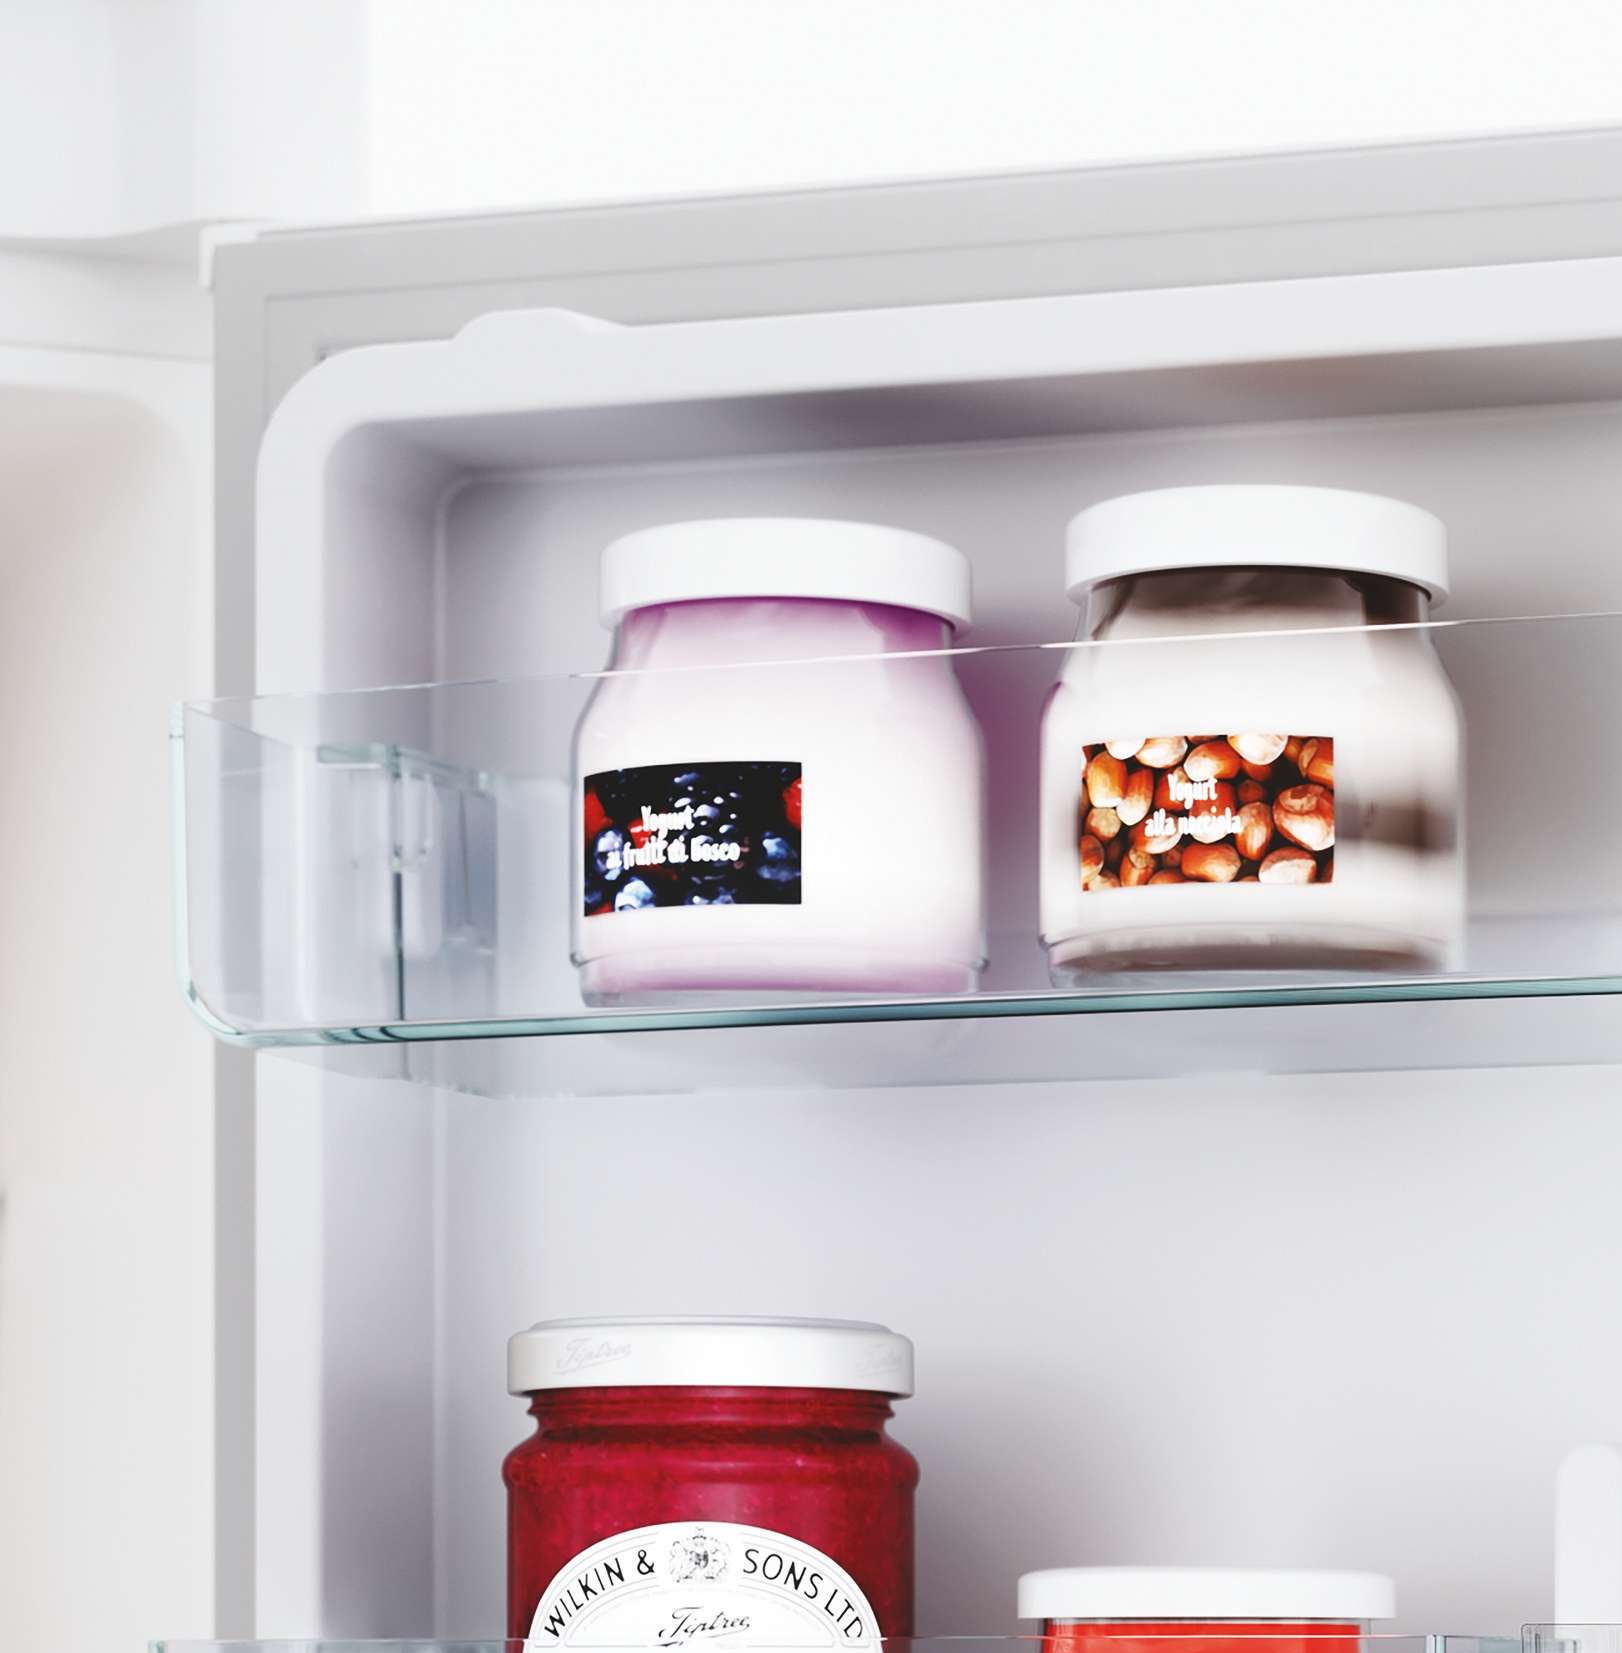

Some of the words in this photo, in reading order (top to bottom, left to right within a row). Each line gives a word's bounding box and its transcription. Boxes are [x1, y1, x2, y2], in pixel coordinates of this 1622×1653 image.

[1167, 773, 1218, 810] Yogurt
[543, 1556, 626, 1639] WILKIN
[636, 1549, 655, 1576] &
[742, 1548, 824, 1600] SONS
[823, 1588, 864, 1639] LTD
[652, 1605, 752, 1649] Tiptree
